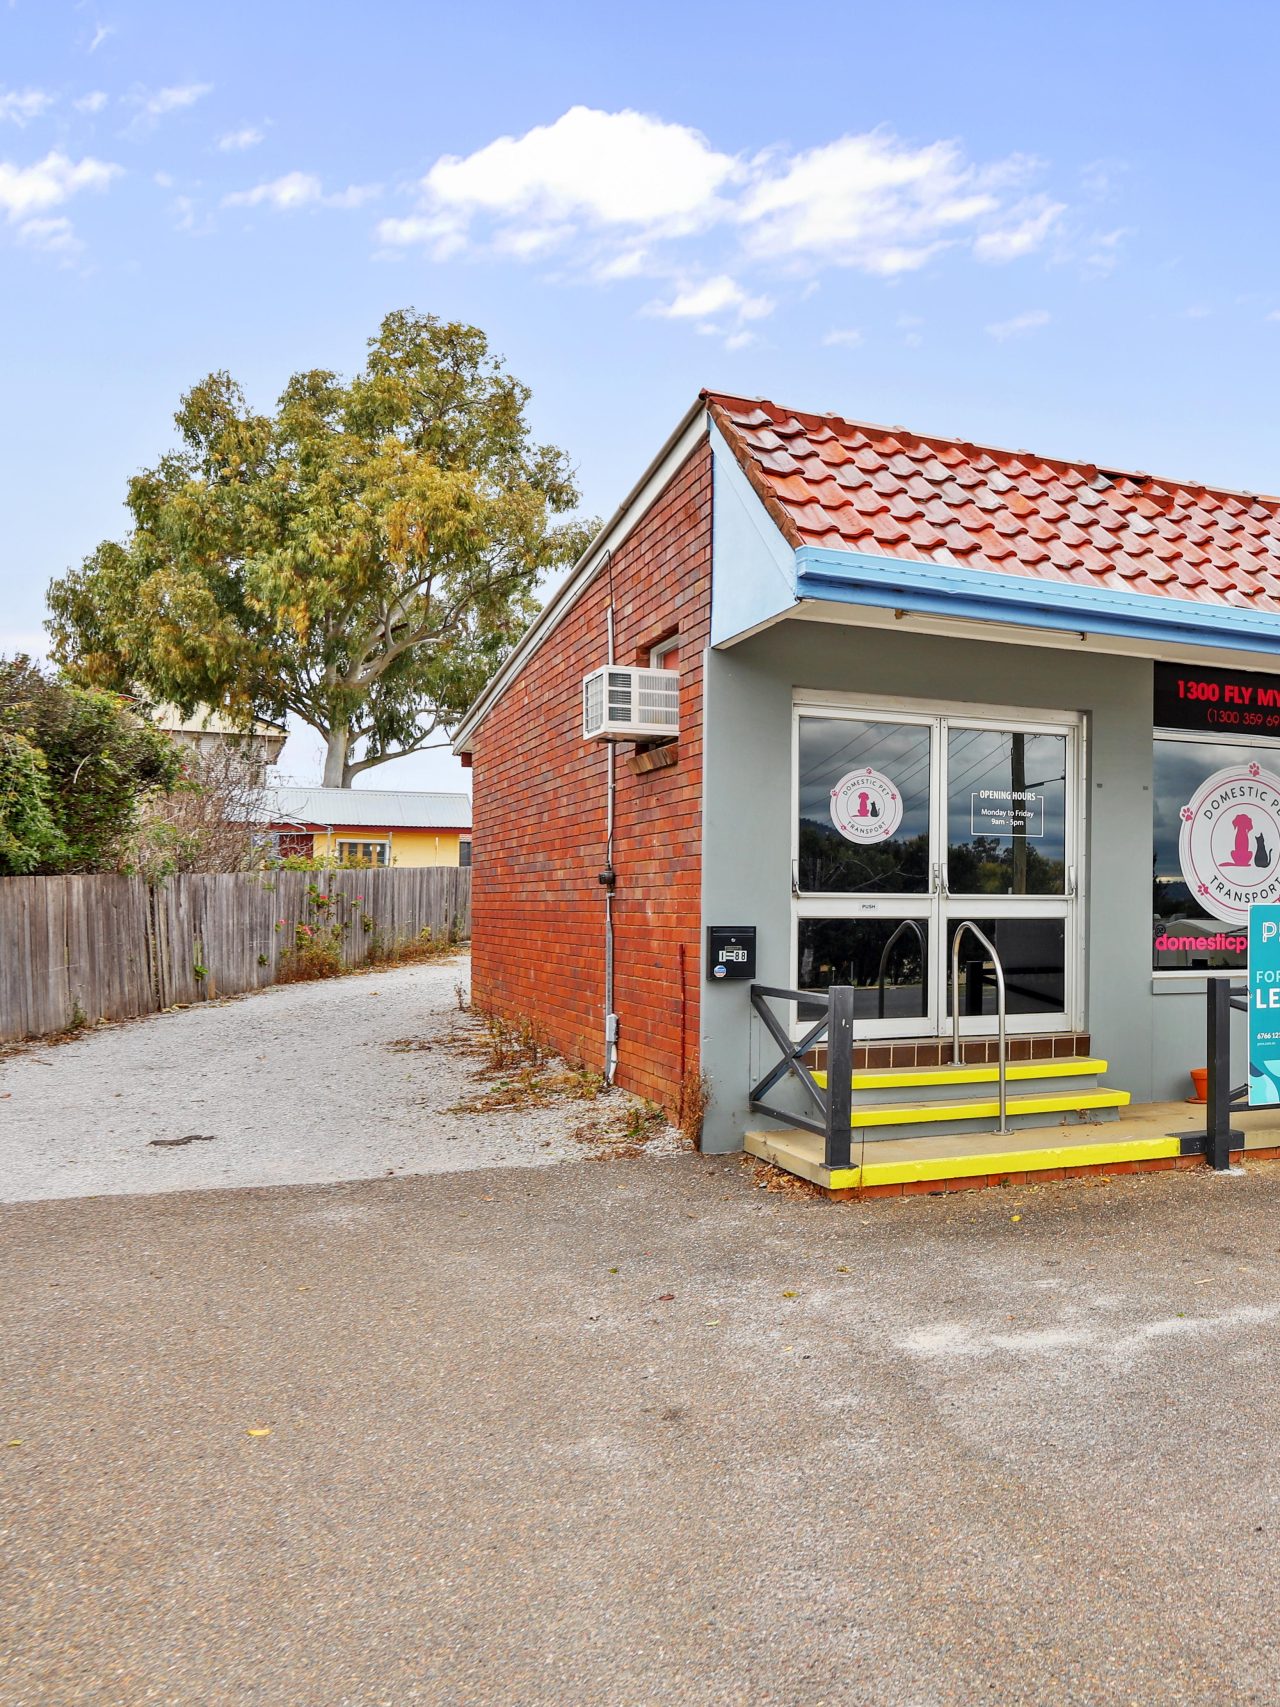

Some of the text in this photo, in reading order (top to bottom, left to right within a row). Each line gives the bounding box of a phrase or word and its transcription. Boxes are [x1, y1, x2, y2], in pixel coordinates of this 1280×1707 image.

[1177, 680, 1220, 702] 1300
[1224, 685, 1253, 705] FLY
[1207, 708, 1239, 724] (1300
[1243, 711, 1263, 726] 359
[843, 778, 890, 796] DOMESTIC PET
[980, 790, 1036, 801] OPENING HOURS
[1203, 786, 1268, 820] DOMESTIC
[981, 808, 1007, 817] Monday
[1015, 809, 1034, 819] Friday
[847, 820, 886, 834] TRANSPORT
[1010, 819, 1024, 827] 5pm
[1155, 934, 1248, 953] domesticp
